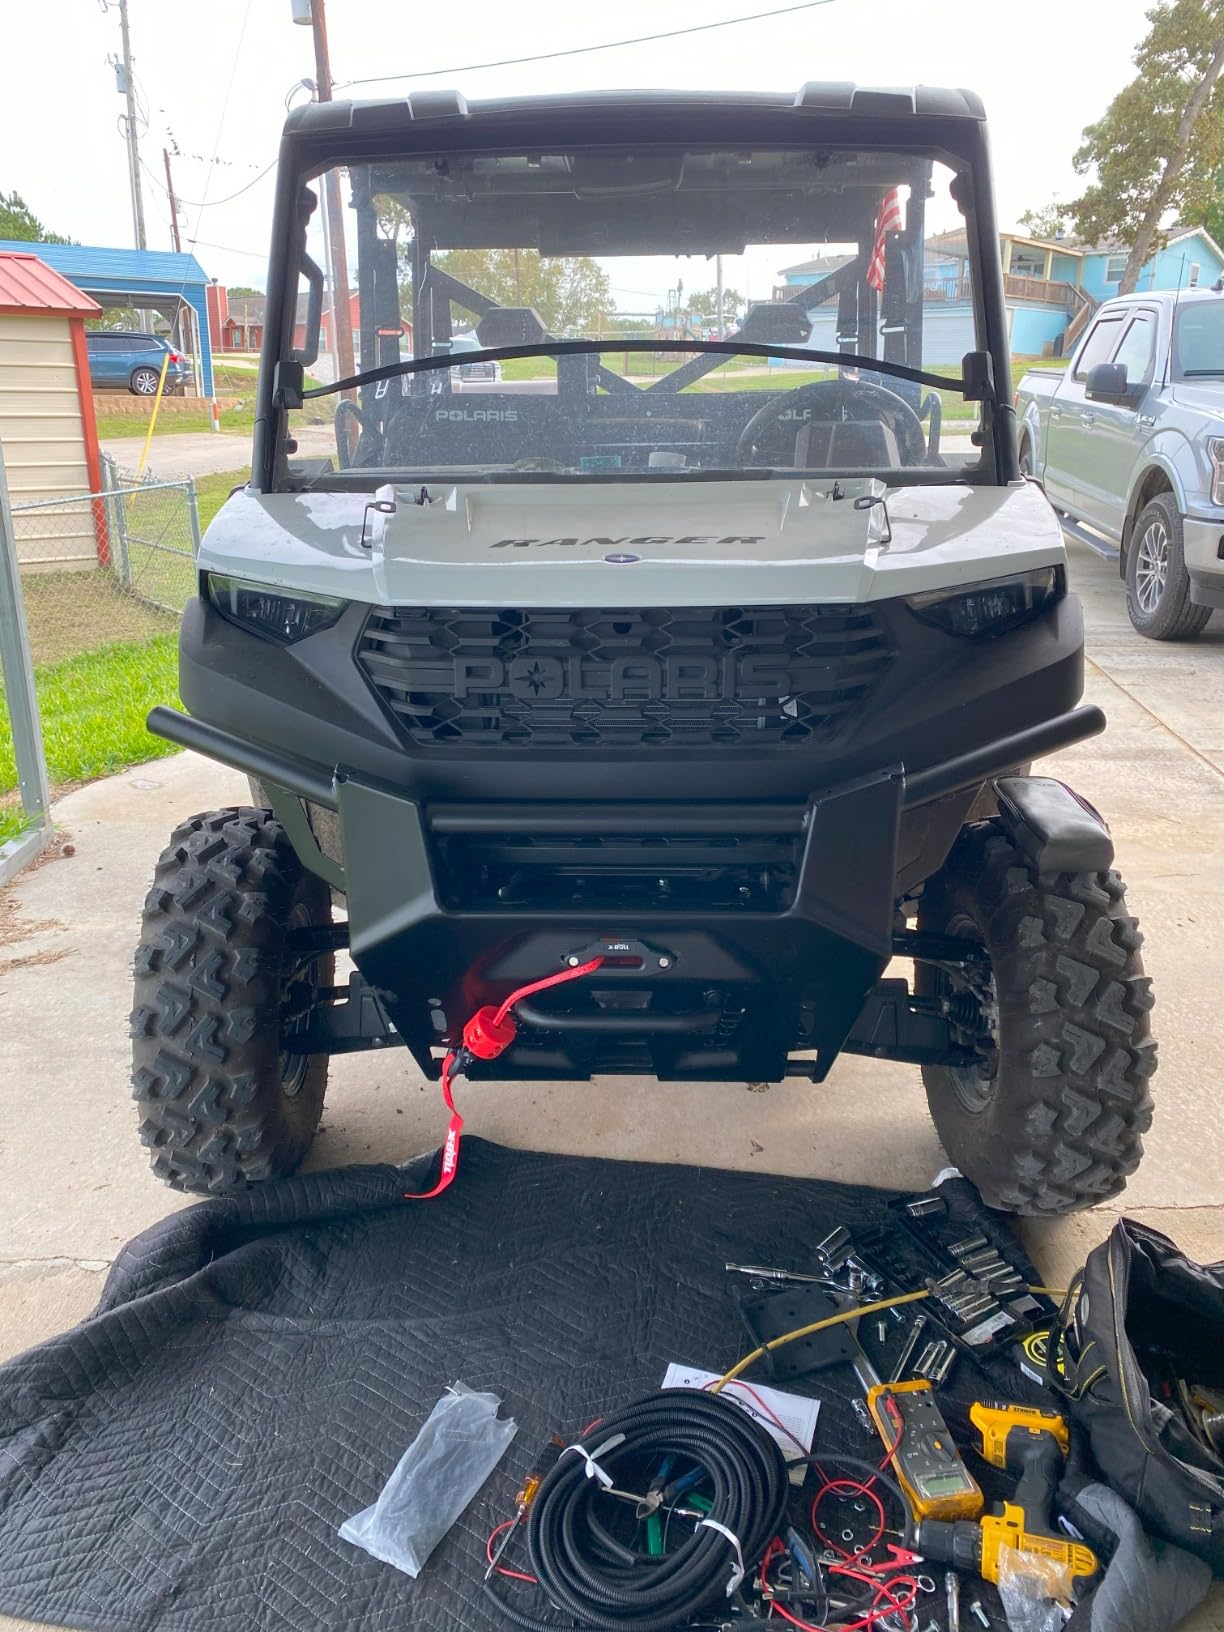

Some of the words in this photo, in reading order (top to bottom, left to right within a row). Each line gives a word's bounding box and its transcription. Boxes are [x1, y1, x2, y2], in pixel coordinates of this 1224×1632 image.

[435, 410, 518, 421] POLARIS
[489, 536, 767, 549] RANGER
[452, 656, 793, 700] POLARIS
